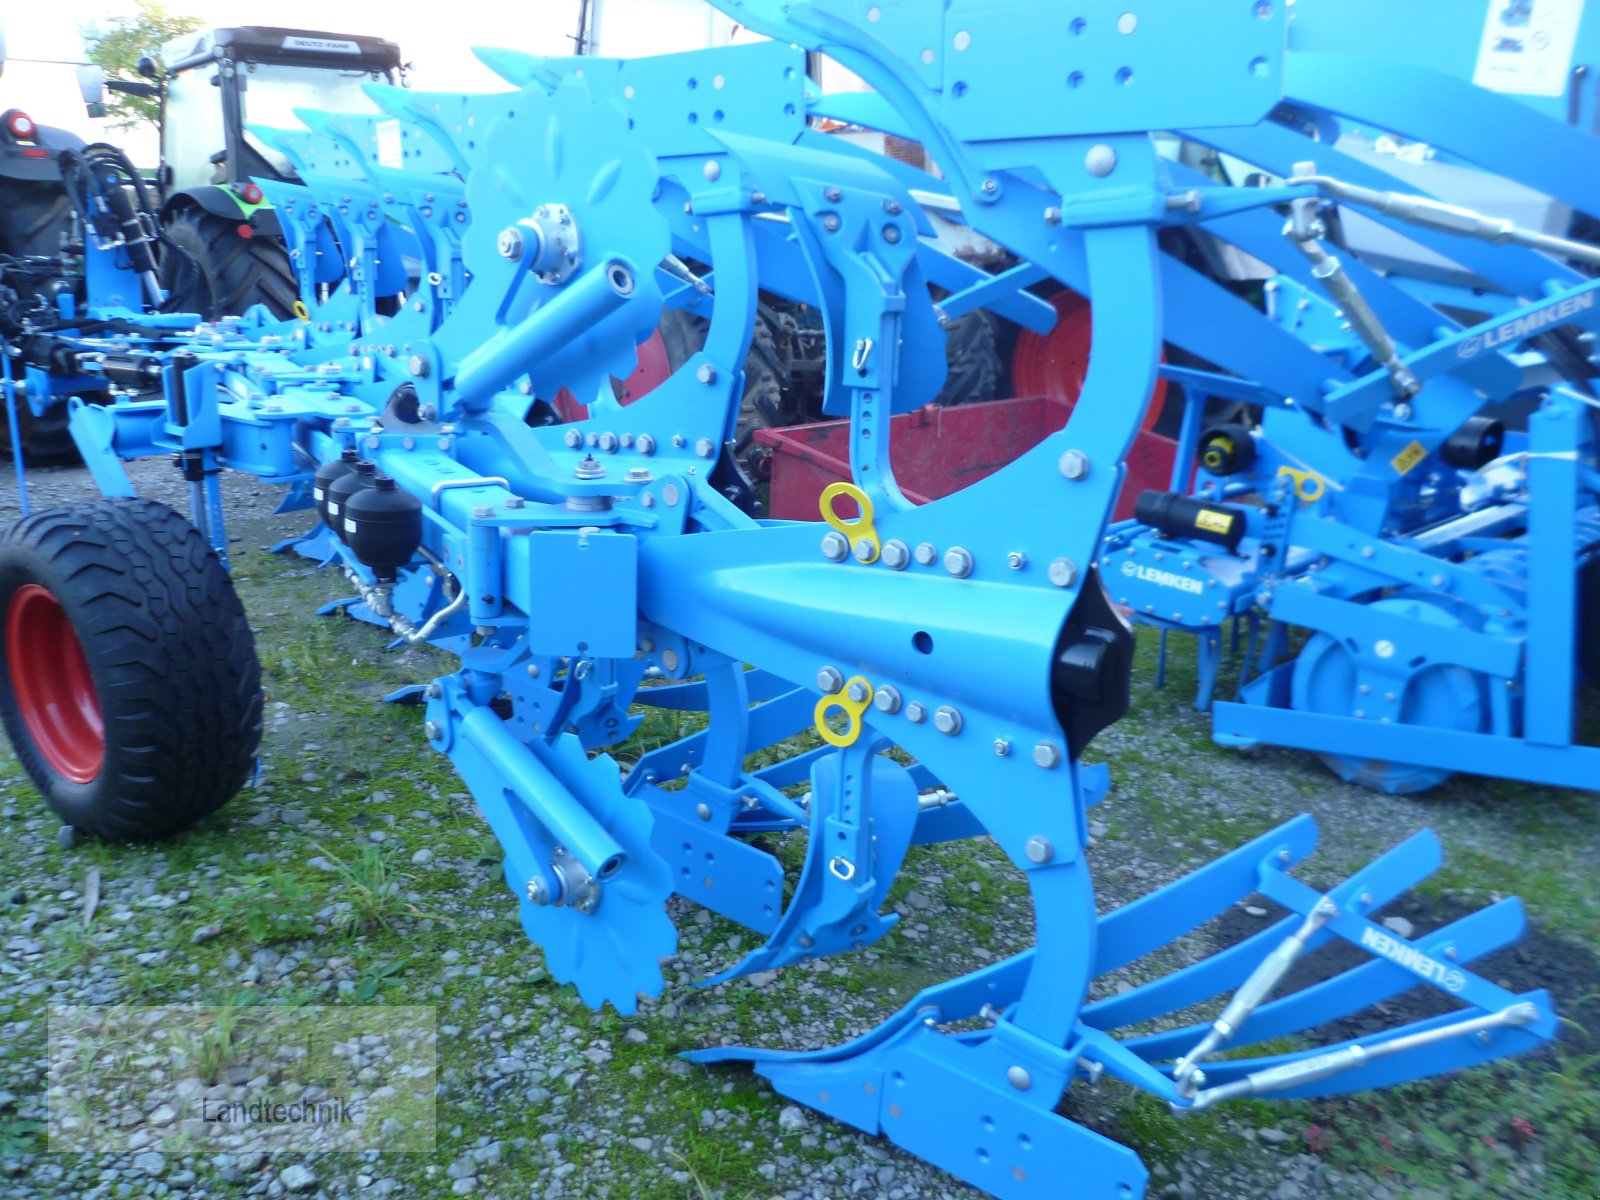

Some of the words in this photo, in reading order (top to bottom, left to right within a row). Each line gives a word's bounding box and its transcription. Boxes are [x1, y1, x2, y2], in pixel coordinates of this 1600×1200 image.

[1484, 290, 1594, 349] LEMKEN
[1136, 565, 1204, 595] LEMKEN
[1361, 926, 1447, 982] LEMKEN
